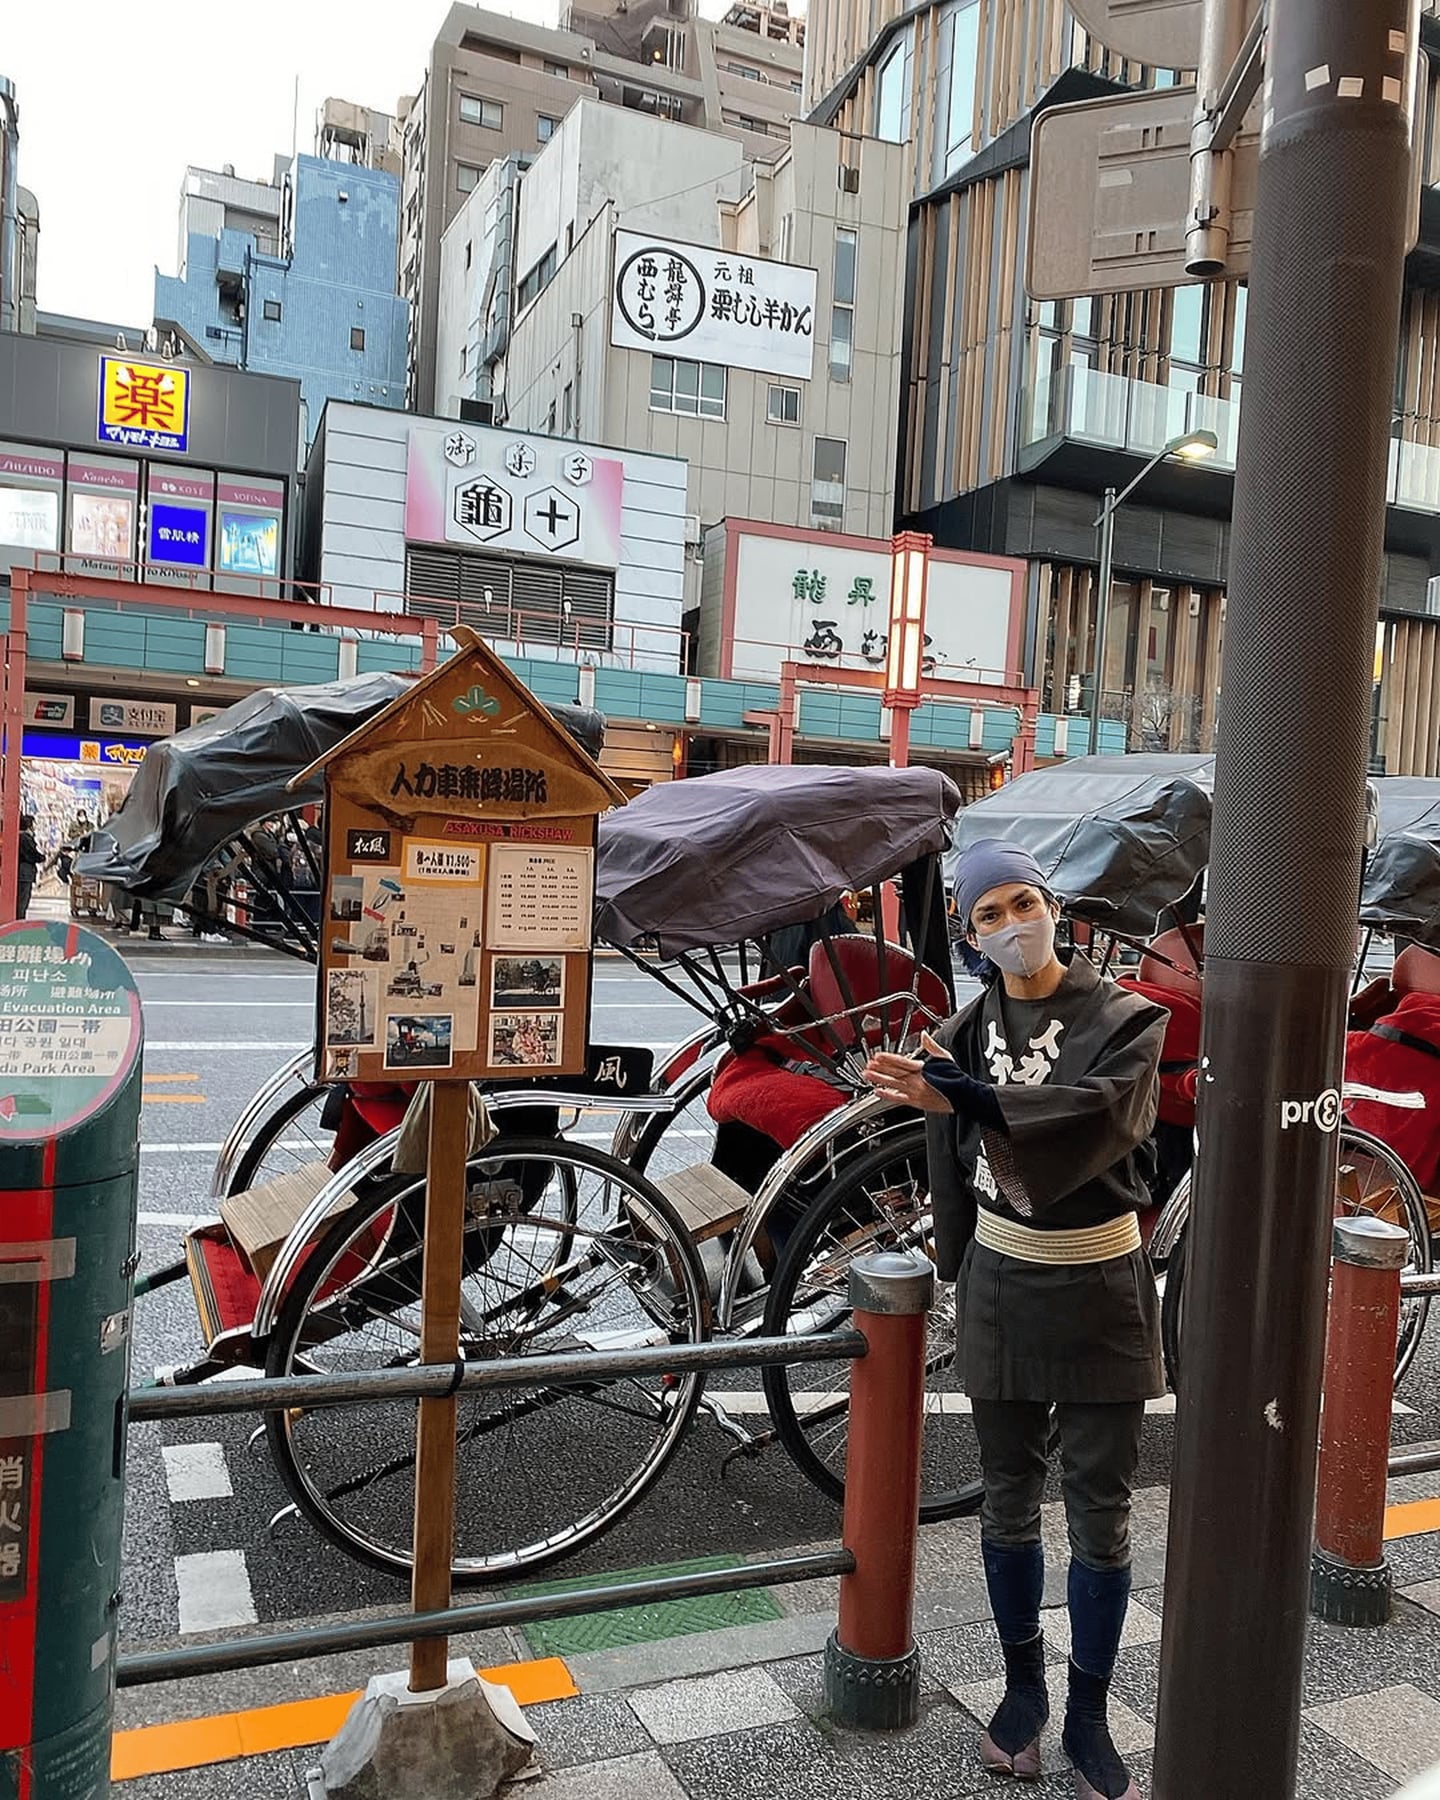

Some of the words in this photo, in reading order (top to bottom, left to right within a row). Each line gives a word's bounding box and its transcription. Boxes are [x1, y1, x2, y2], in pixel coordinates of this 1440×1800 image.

[713, 261, 755, 286] 元祖
[636, 258, 659, 330] 西むら
[710, 287, 812, 337] 栗むし羊かん
[114, 366, 175, 431] 薬
[445, 821, 505, 838] ASAKUSA
[509, 824, 575, 841] RICKSHAW
[11, 968, 68, 983] 피난소
[2, 1001, 84, 1013] Evacuation
[87, 1003, 121, 1015] Area
[22, 1063, 57, 1074] Park
[61, 1063, 96, 1074] Area
[594, 1055, 627, 1089] 風
